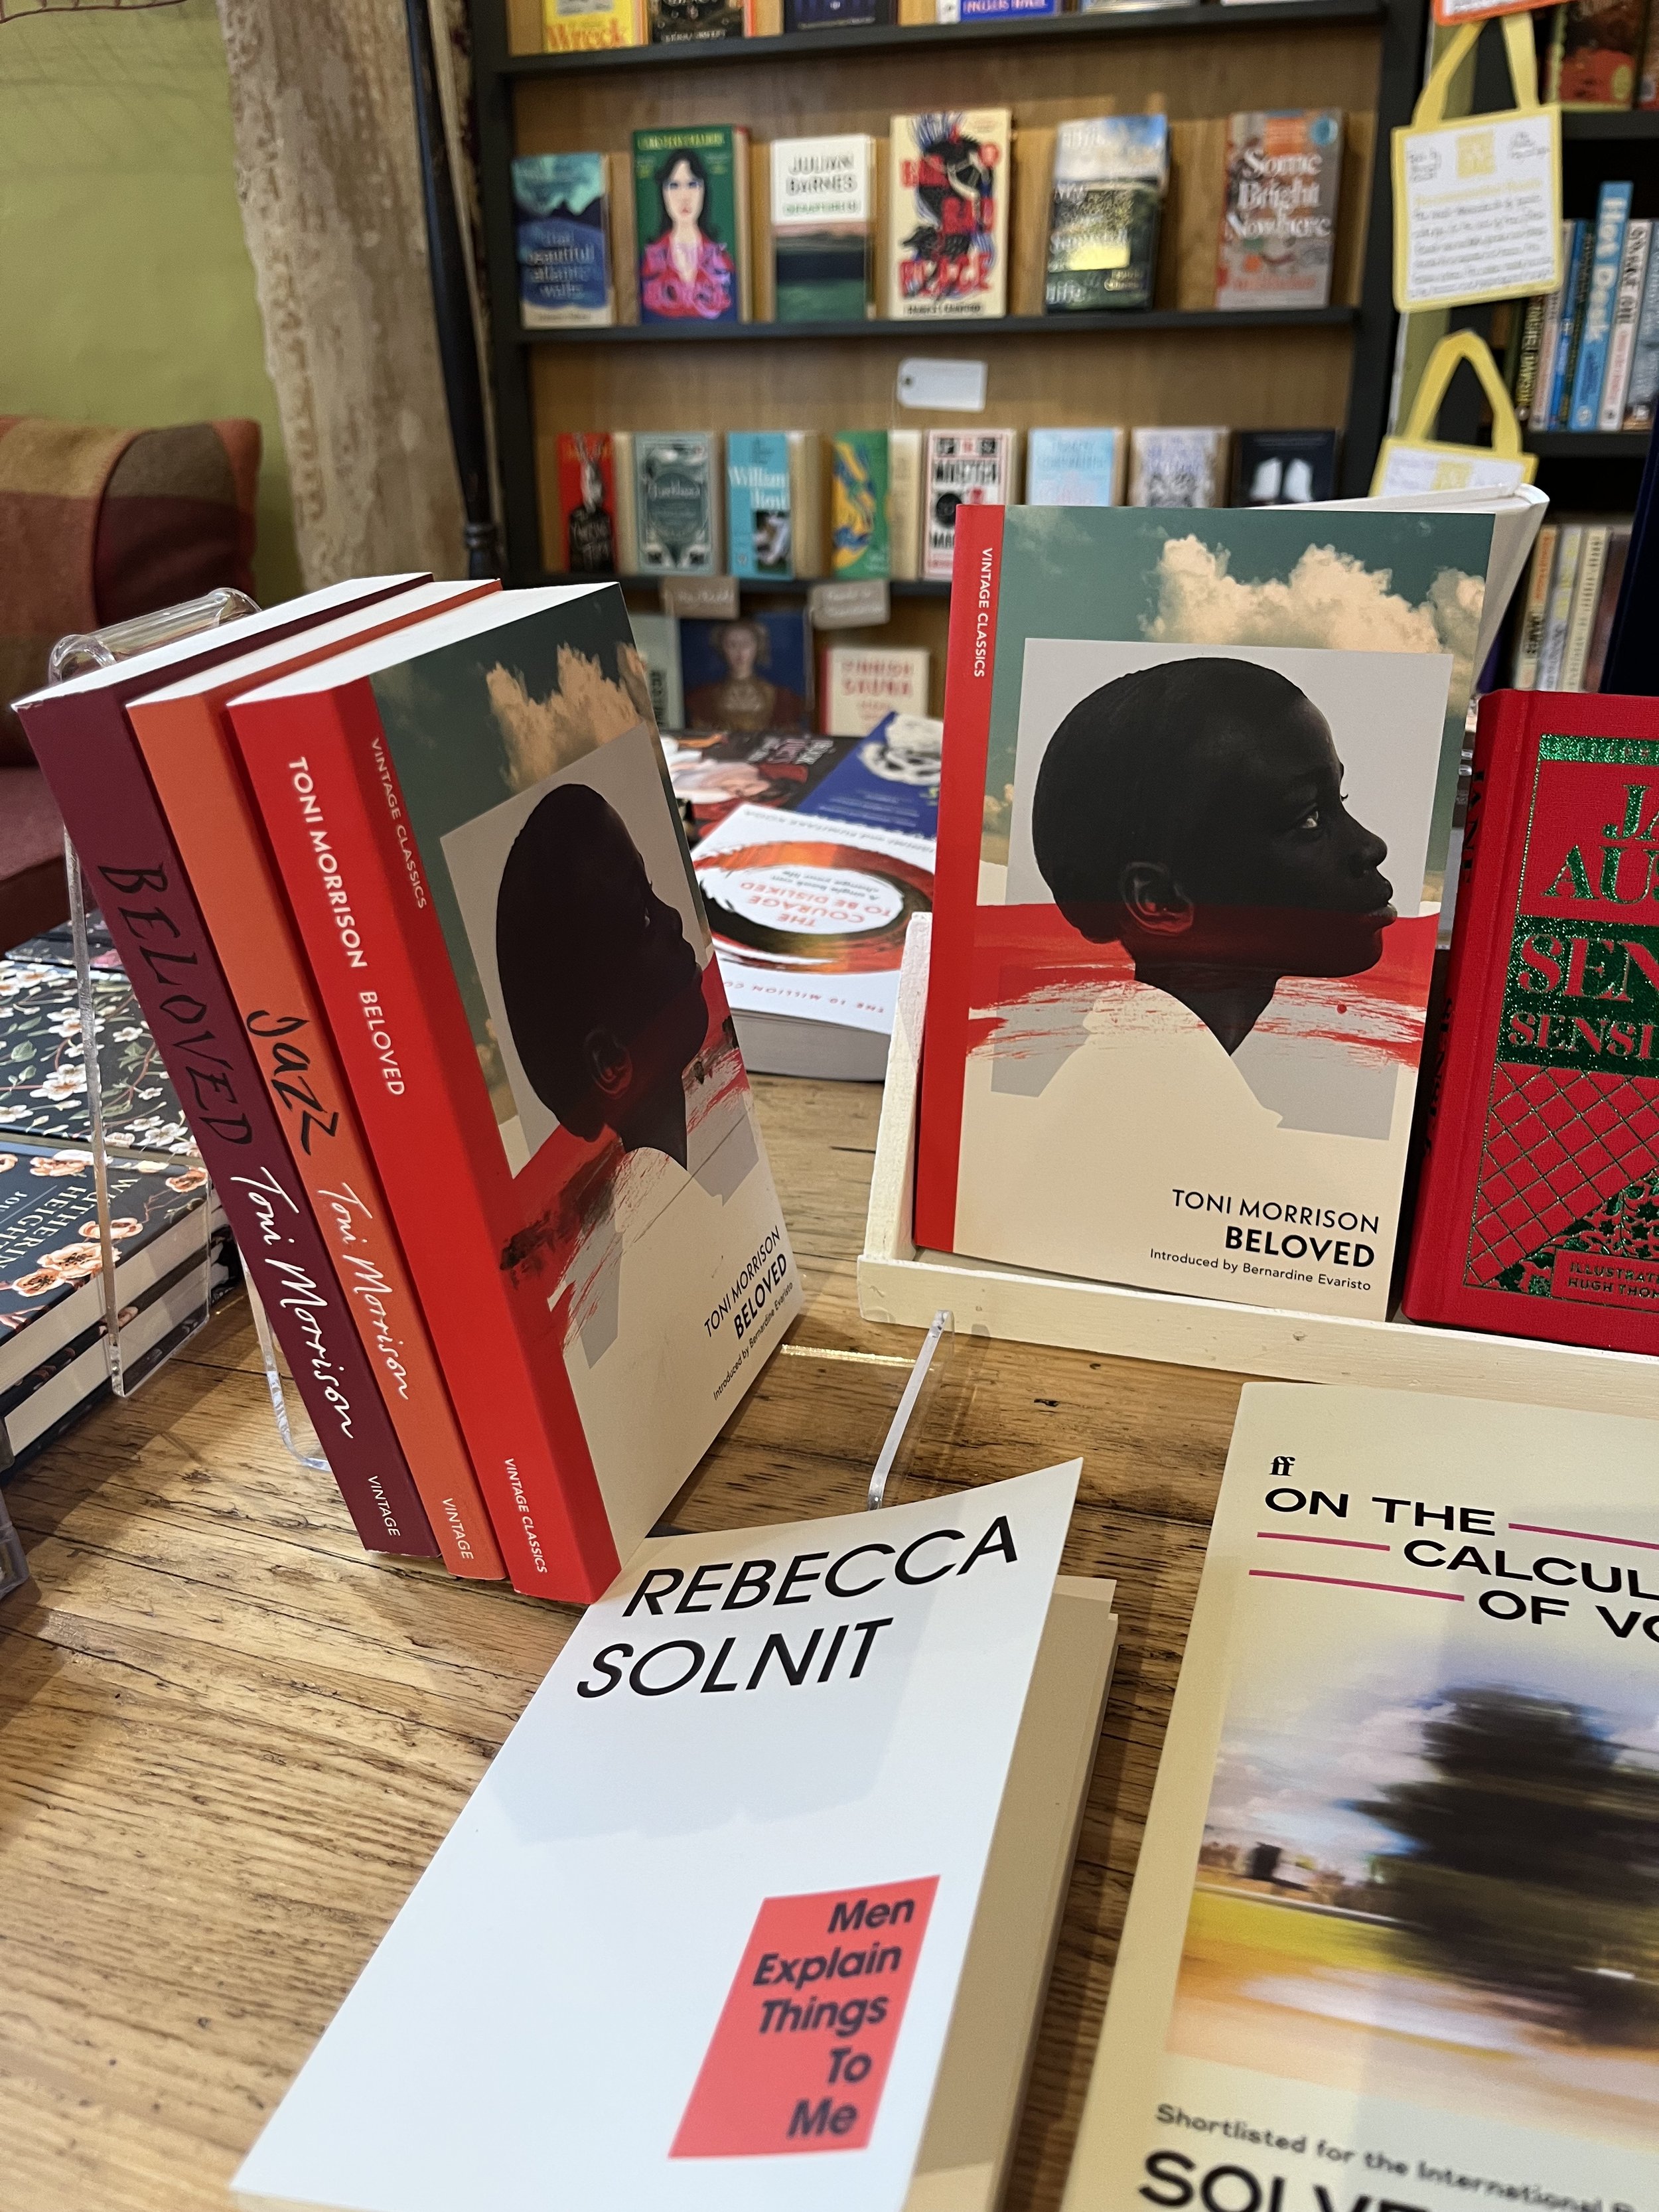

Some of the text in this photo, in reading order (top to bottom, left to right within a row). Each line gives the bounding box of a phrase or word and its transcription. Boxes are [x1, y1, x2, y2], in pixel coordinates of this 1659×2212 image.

[974, 547, 993, 678] VINTAGE CLASSICS
[371, 737, 427, 909] VINTAGE CLASSICS
[739, 881, 892, 918] TO BE DISLIKED
[1542, 844, 1659, 905] AU
[289, 757, 405, 1097] TONI MORRISON BELOVED
[746, 895, 865, 924] COURAGE
[775, 913, 817, 928] THE
[99, 863, 253, 1145] BELOVED
[752, 985, 822, 1001] MILLION
[1172, 1188, 1379, 1234] TONI MORRISON
[1150, 1248, 1372, 1291] Introduced by Bernardine Evaristo
[1225, 1225, 1375, 1268] BELOVED
[231, 1166, 354, 1439] Toni Morrison
[318, 1182, 408, 1400] Toni Morrison
[704, 1224, 780, 1338] TONI MORRISON
[733, 1252, 787, 1340] BELOVED
[1568, 1276, 1614, 1293] HUGH
[713, 1282, 794, 1402] Introduced by Bernardine Evaristo
[368, 1474, 401, 1538] VINTAGE
[442, 1497, 474, 1560] VINTAGE
[504, 1457, 547, 1574] VINTAGE CLASSICS
[1264, 1487, 1496, 1536] ON THE
[622, 1514, 1019, 1617] REBECCA
[1479, 1589, 1569, 1625] OF
[576, 1617, 894, 1698] SOLNIT
[827, 1898, 915, 1935] Men
[752, 1942, 902, 1991] Explain
[758, 1996, 889, 2038] Things
[827, 2046, 873, 2085] To
[786, 2096, 859, 2140] Me
[1156, 2102, 1307, 2155] Shortlisted
[1315, 2138, 1356, 2164] for
[1364, 2151, 1407, 2177] the
